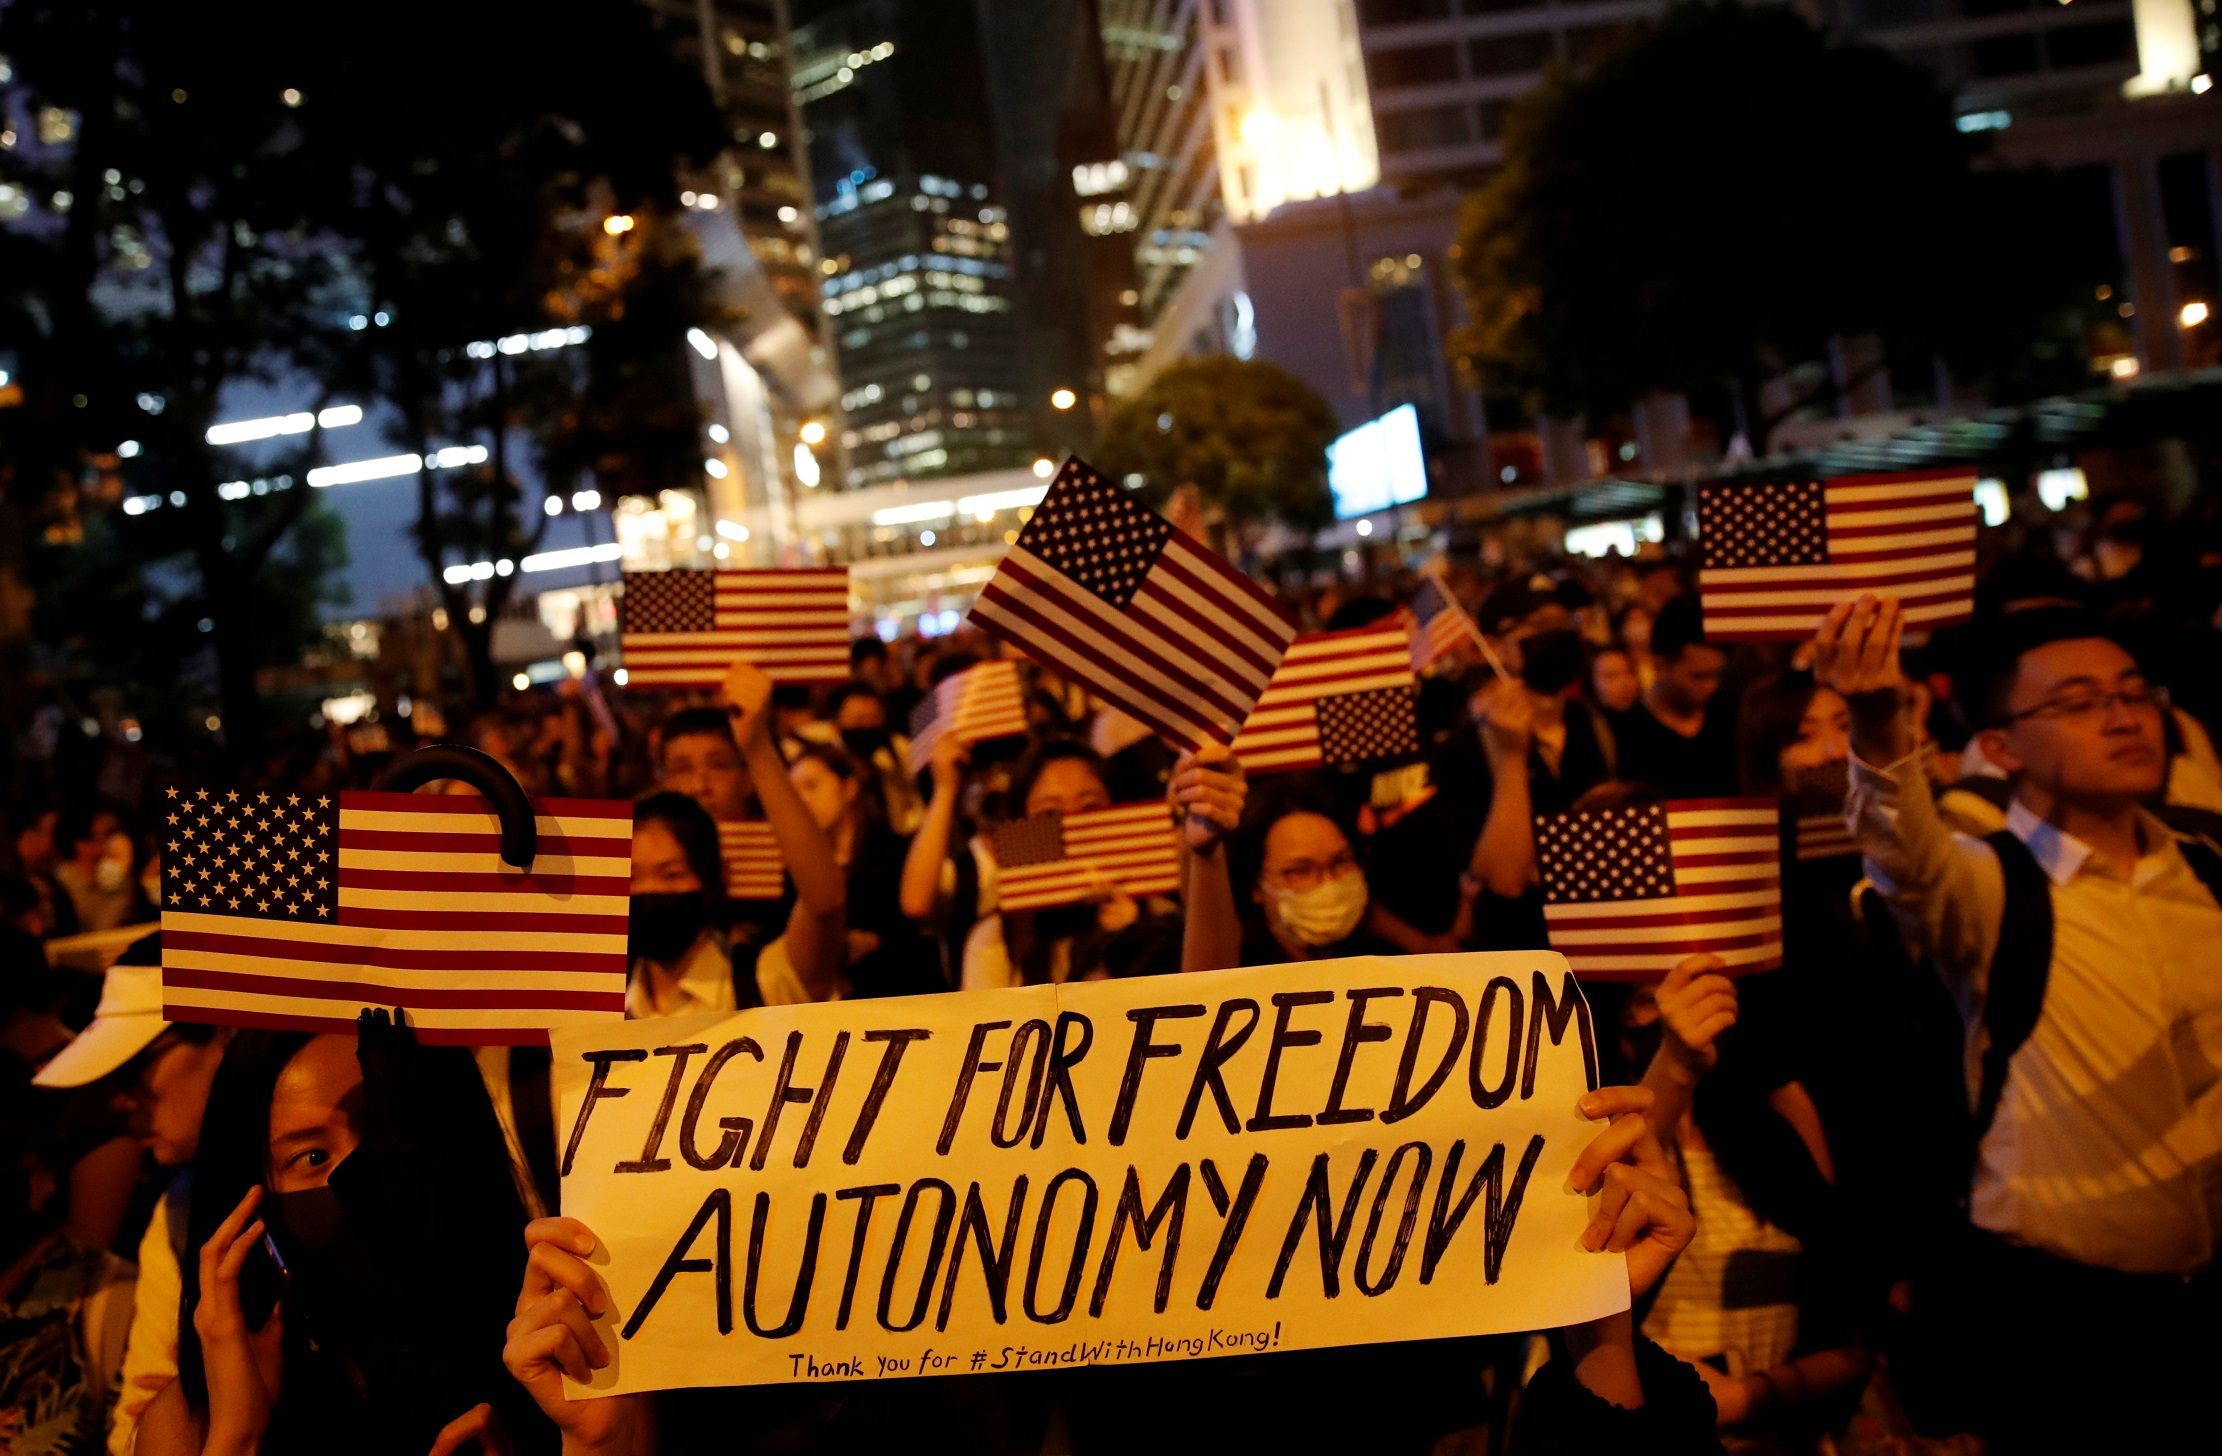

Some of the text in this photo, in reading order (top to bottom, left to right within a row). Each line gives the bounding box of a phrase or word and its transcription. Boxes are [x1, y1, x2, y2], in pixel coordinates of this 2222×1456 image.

[561, 969, 1598, 1176] FIGHT FOR FREEDOM
[621, 1135, 1545, 1340] AUTONOMY NOW
[788, 1353, 865, 1378] Thank
[877, 1355, 911, 1378] you
[918, 1348, 958, 1375] for
